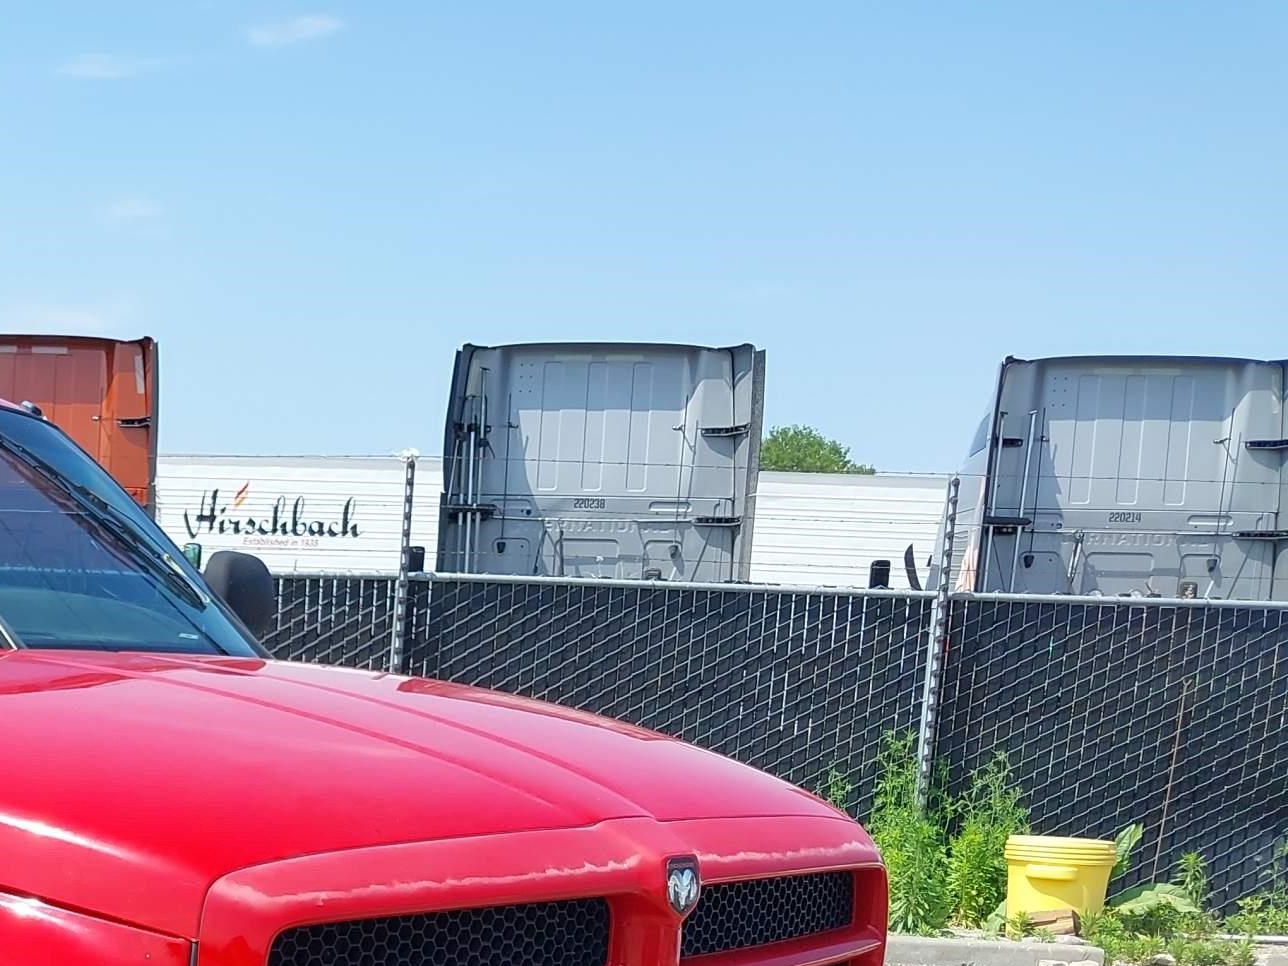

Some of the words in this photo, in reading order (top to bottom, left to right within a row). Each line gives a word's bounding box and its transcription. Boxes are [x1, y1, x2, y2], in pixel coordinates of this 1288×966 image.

[573, 498, 606, 509] 220238
[184, 488, 365, 539] Hirschbach
[1108, 512, 1142, 523] 220214
